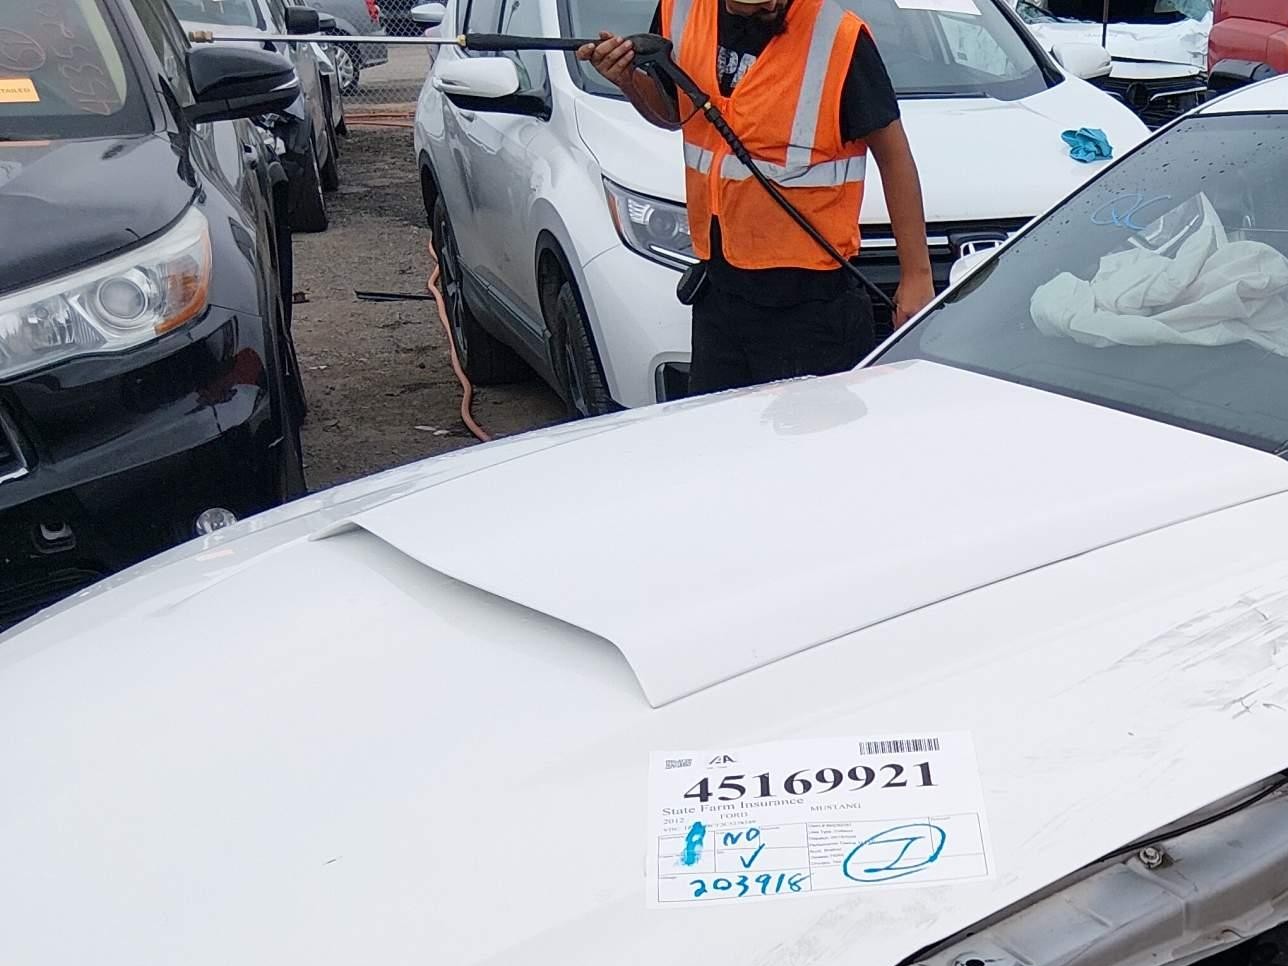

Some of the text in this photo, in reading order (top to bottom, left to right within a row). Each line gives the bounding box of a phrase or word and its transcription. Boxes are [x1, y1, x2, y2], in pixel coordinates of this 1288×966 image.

[683, 762, 939, 803] 45169921
[662, 798, 805, 816] State Farm Insurance
[720, 812, 748, 820] FORD
[810, 803, 861, 812] MUSTANG
[723, 826, 760, 846] NO
[690, 872, 810, 897] 203918
